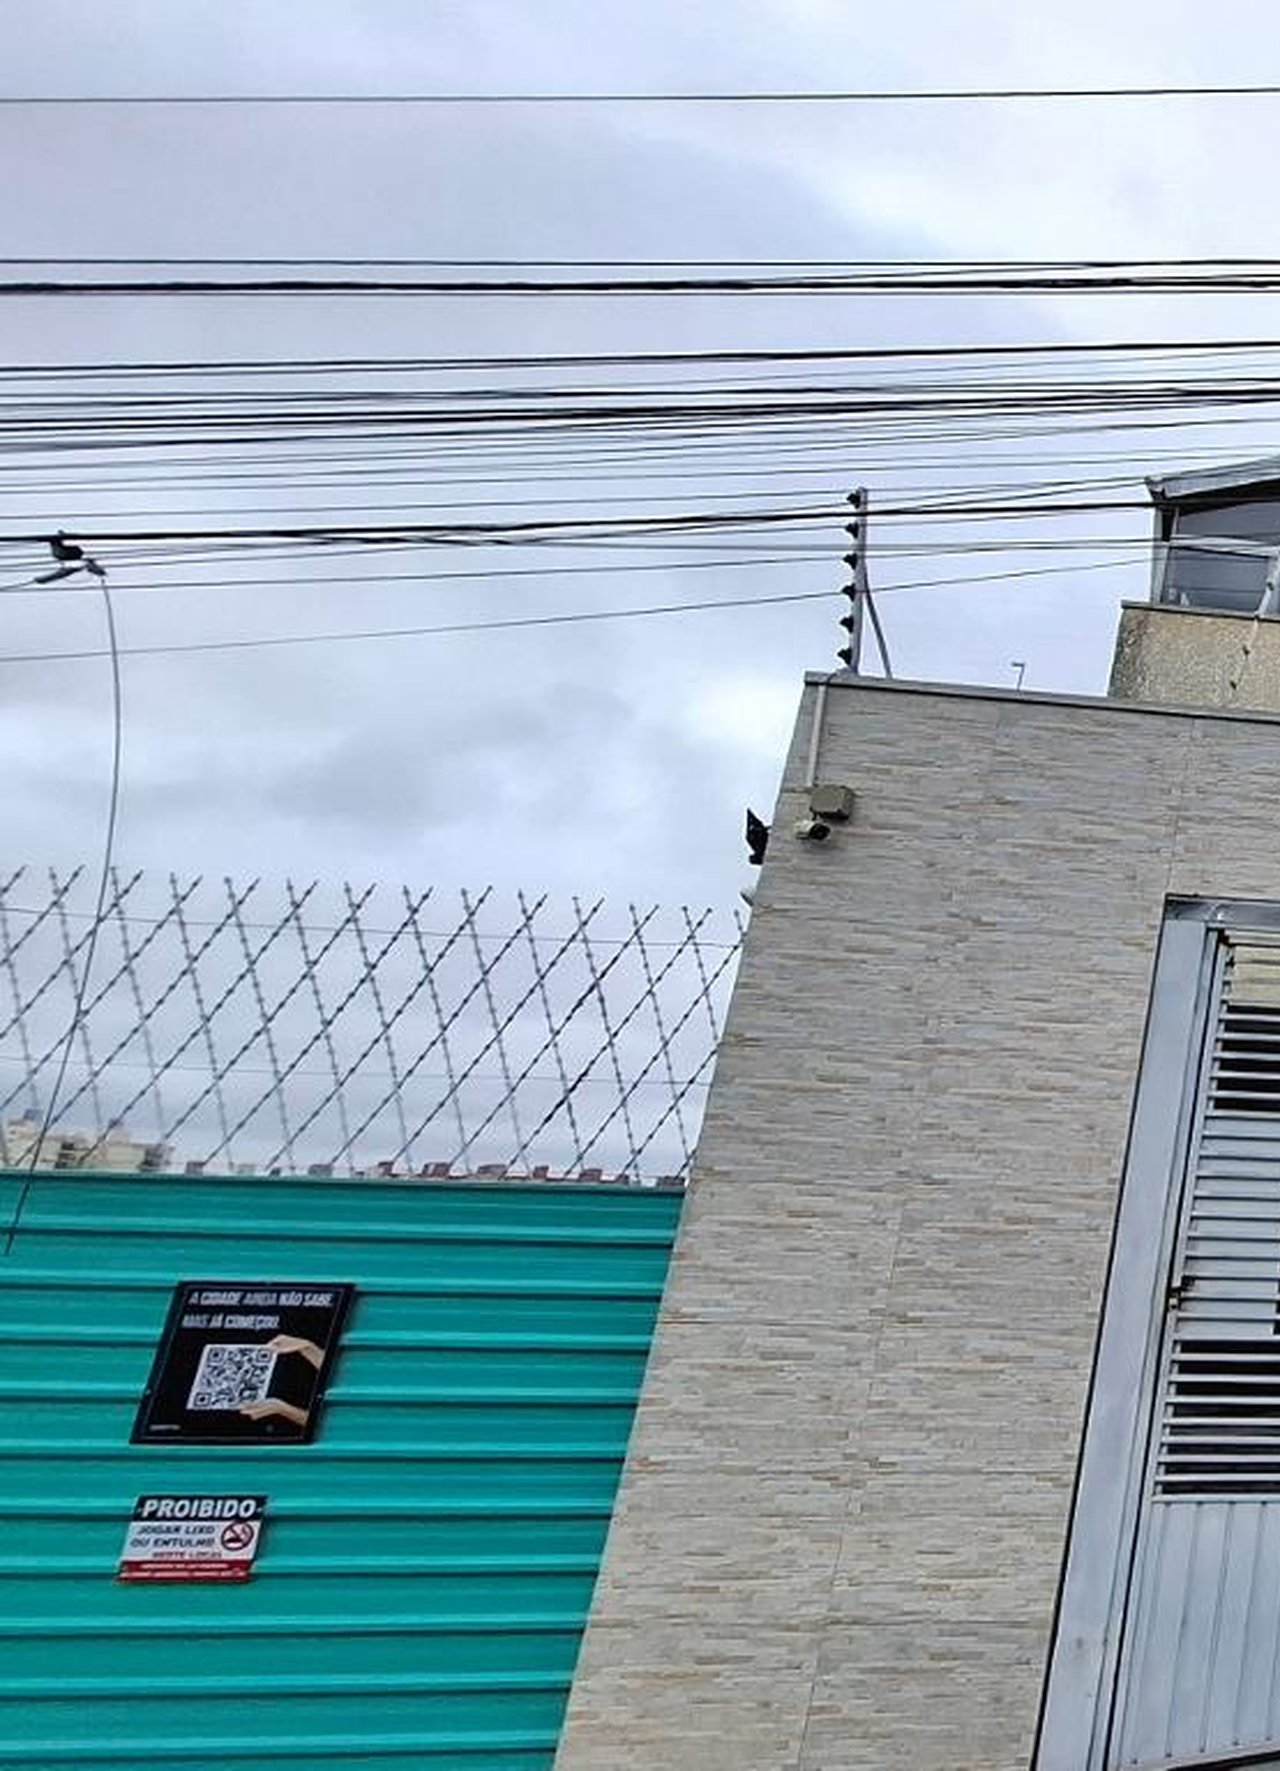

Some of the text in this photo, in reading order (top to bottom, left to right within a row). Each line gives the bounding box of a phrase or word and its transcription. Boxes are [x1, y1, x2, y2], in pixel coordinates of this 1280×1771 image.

[142, 1499, 257, 1518] PROIBIDO
[138, 1525, 216, 1534] JOGAR LIXO
[131, 1537, 150, 1546] OU
